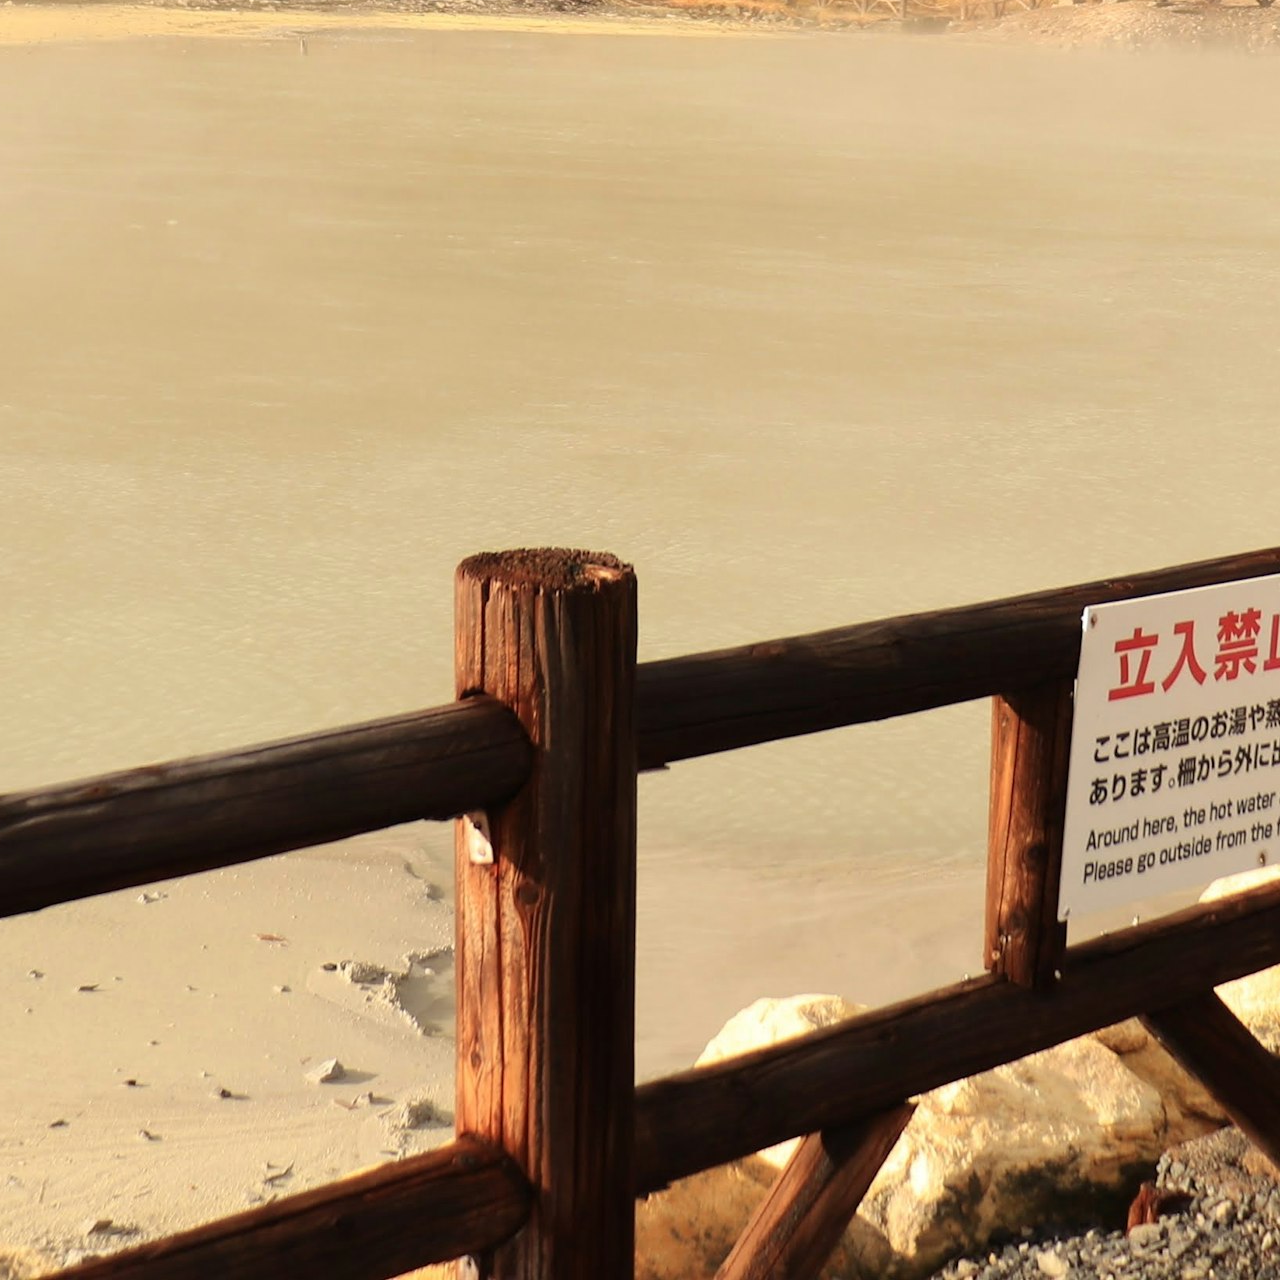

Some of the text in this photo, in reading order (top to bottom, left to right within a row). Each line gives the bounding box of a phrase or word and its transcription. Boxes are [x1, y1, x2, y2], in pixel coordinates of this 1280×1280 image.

[1086, 819, 1140, 852] Around
[1143, 816, 1179, 838] here,
[1183, 805, 1207, 829] the
[1209, 800, 1233, 822] hot
[1236, 790, 1276, 816] water
[1083, 857, 1133, 885] Please
[1137, 851, 1156, 873] go
[1159, 835, 1212, 865] outside
[1216, 829, 1247, 851] from
[1250, 821, 1273, 842] the
